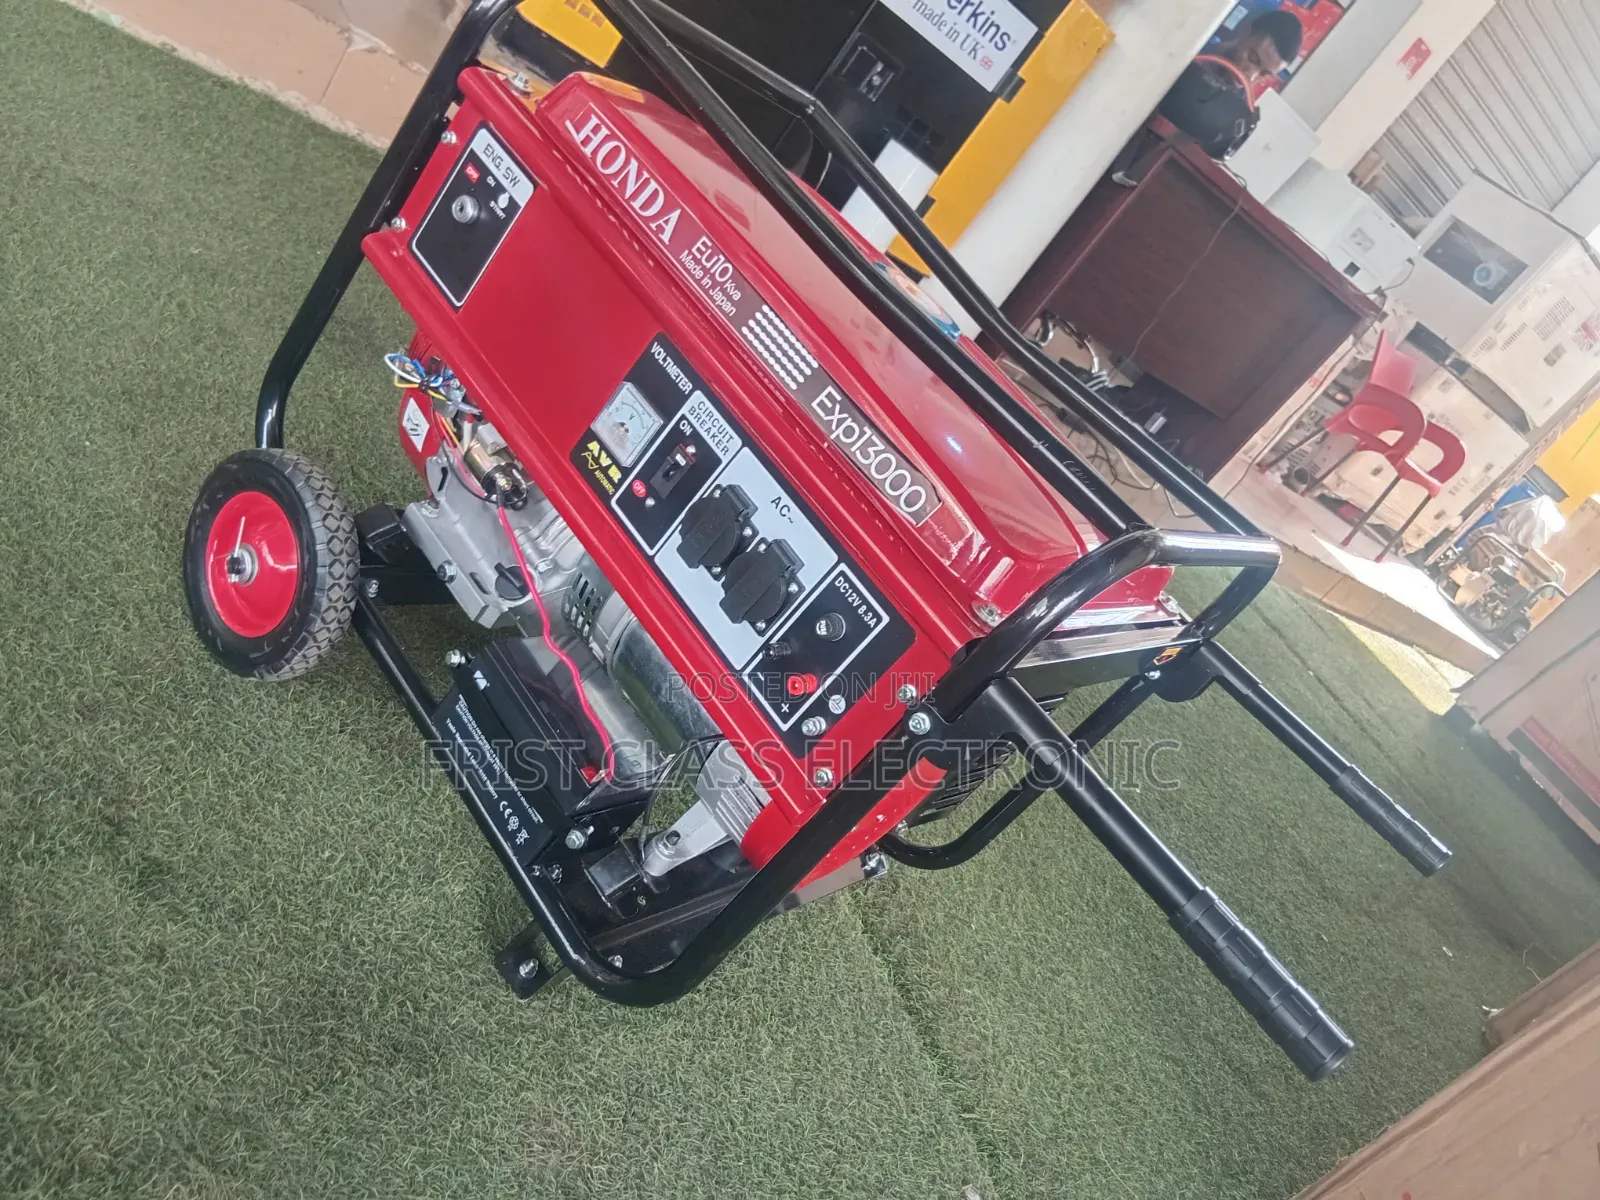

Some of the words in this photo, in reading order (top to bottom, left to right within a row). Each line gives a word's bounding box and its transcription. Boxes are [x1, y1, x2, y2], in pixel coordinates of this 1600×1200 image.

[912, 2, 949, 32] made
[945, 23, 961, 44] in
[959, 34, 985, 60] UK
[482, 143, 502, 172] ENG.
[503, 167, 521, 188] SW
[576, 113, 681, 246] HONDA
[678, 251, 704, 282] Made
[699, 275, 713, 292] in
[708, 287, 737, 317] Japan
[650, 342, 694, 395] VOLTMETER
[679, 420, 693, 436] ON
[688, 407, 730, 458] BREAKER
[697, 401, 735, 444] CIRCUIT
[586, 440, 623, 484] AVR
[812, 386, 928, 516] Exp13000
[594, 468, 616, 495] AUTOMATIC
[856, 606, 878, 629] 8.3A
